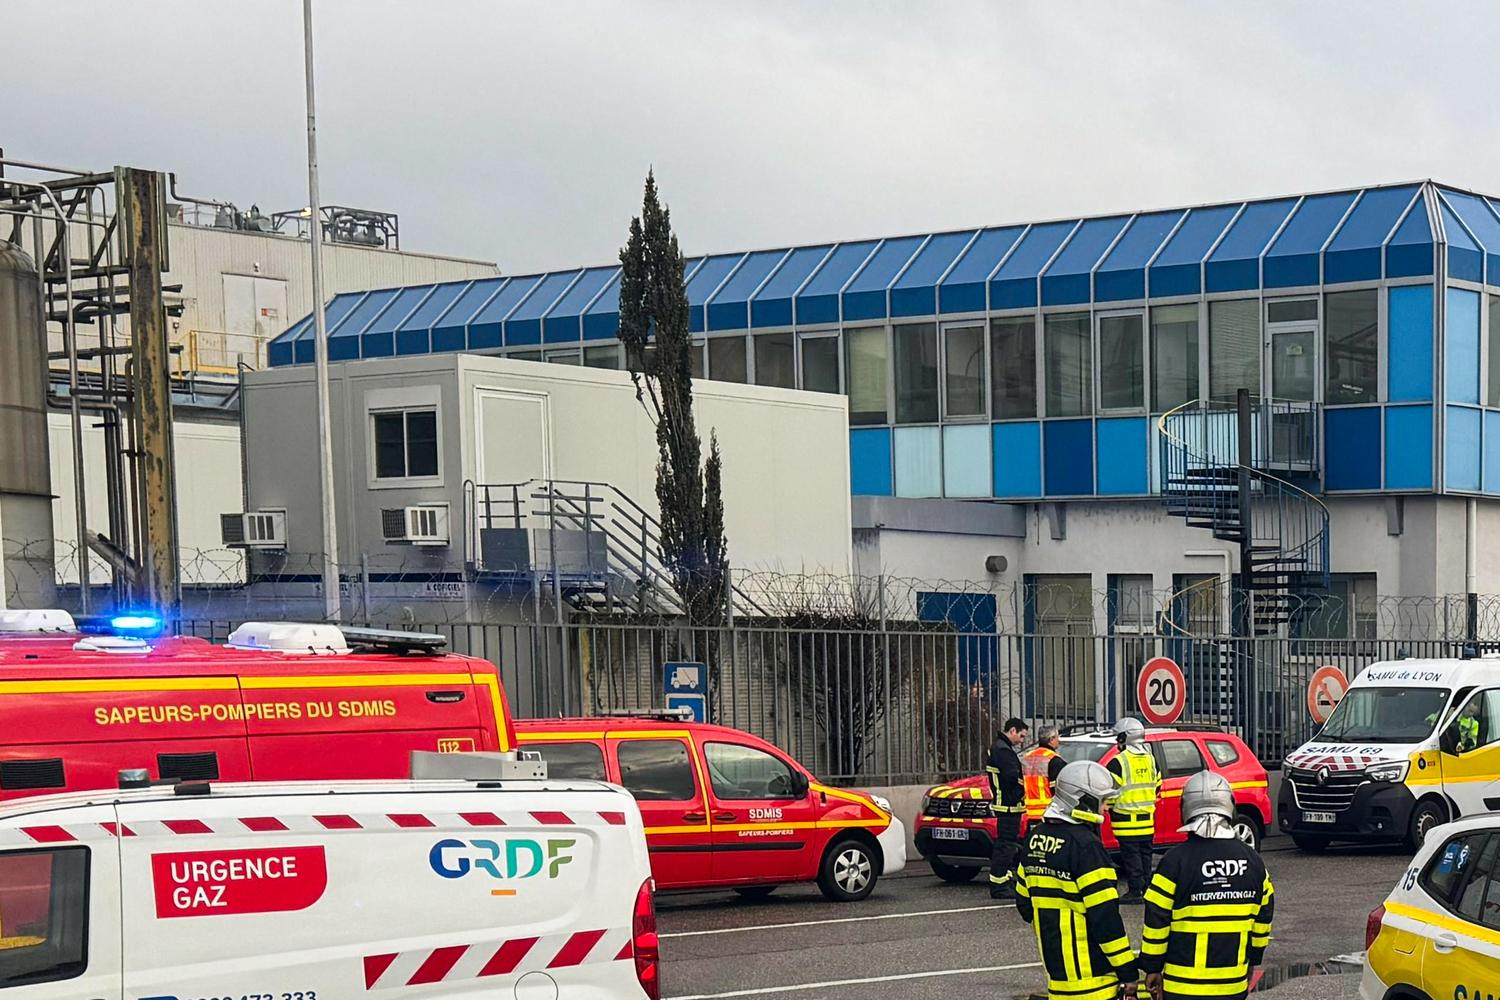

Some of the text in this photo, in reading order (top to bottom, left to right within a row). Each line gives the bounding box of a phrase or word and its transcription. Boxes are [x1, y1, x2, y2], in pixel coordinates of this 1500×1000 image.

[1412, 671, 1441, 682] LYON
[1149, 678, 1176, 706] 20
[95, 700, 396, 725] SAPEURS-POMPIERS DU SDMIS
[440, 741, 460, 752] 112
[1301, 747, 1383, 755] SAMU 69
[749, 808, 783, 819] SDMIS
[1029, 834, 1065, 854] GRDF
[170, 856, 298, 883] URGENCE
[429, 839, 577, 879] GRDF
[1201, 859, 1248, 878] GRDF
[1402, 867, 1419, 891] 15
[173, 885, 228, 909] GAZ
